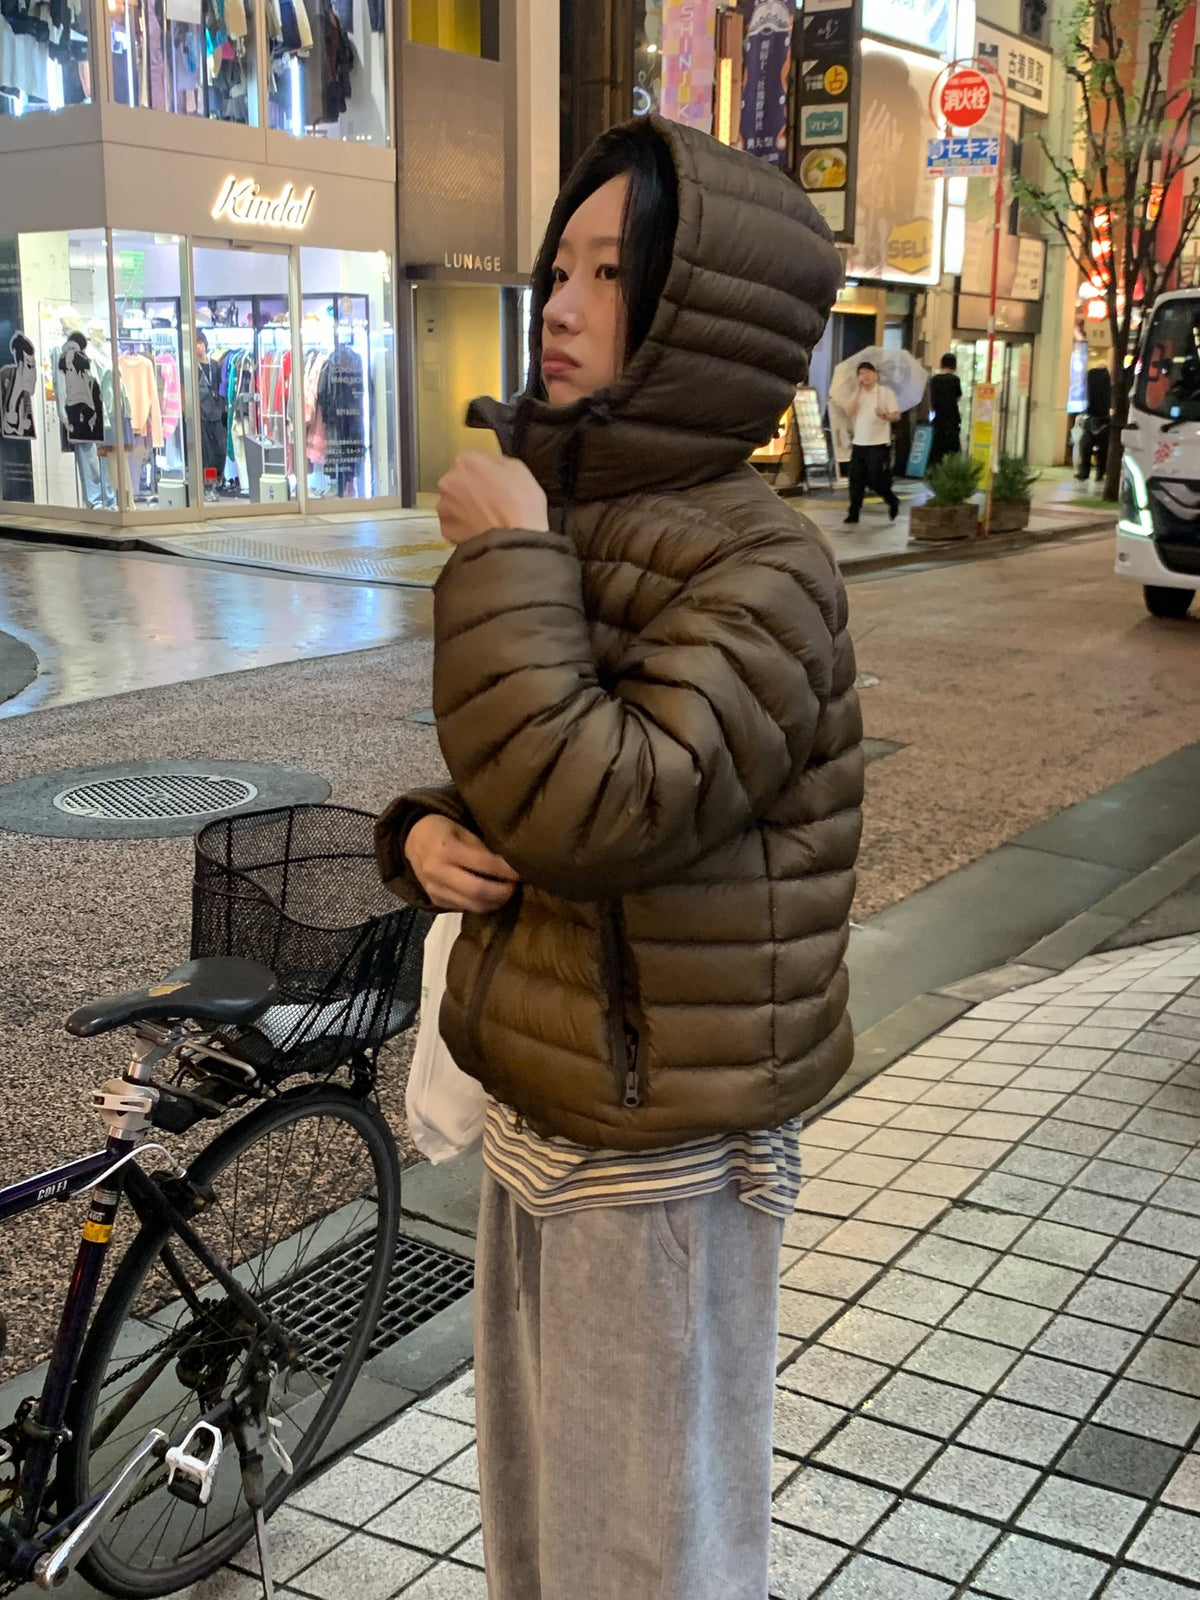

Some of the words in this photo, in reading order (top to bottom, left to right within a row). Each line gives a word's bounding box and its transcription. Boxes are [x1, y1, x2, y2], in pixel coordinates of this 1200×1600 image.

[678, 5, 695, 126] SHINJUK
[828, 66, 844, 93] 占
[943, 85, 988, 112] 消火栓
[210, 174, 316, 230] Kindal
[887, 236, 932, 259] SELL
[444, 251, 502, 272] LUNAGE
